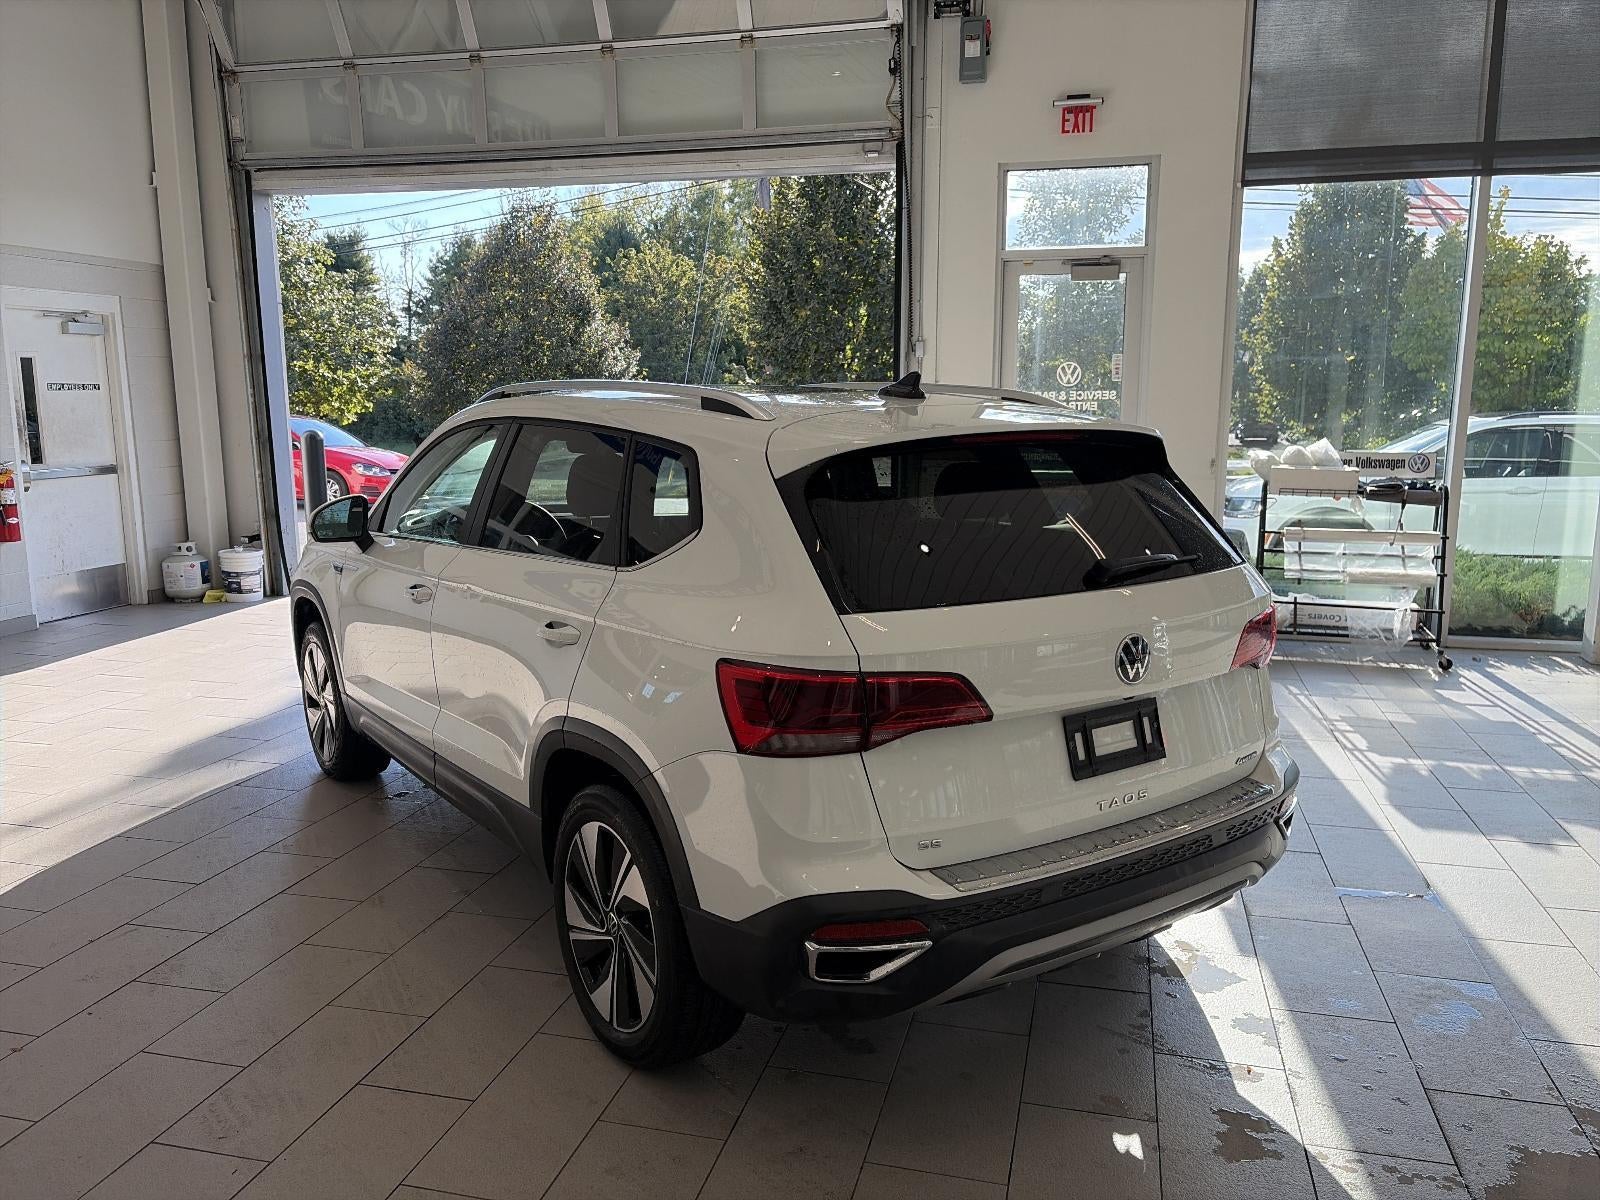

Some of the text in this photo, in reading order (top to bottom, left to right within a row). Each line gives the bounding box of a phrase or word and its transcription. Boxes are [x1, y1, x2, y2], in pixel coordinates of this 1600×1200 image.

[1061, 105, 1097, 134] EXIT
[47, 383, 100, 391] EMPLOYEES ONLY
[1355, 456, 1406, 471] Volkswagen
[1306, 612, 1342, 623] Covers
[1096, 788, 1149, 812] TAOS
[918, 838, 943, 850] SE
